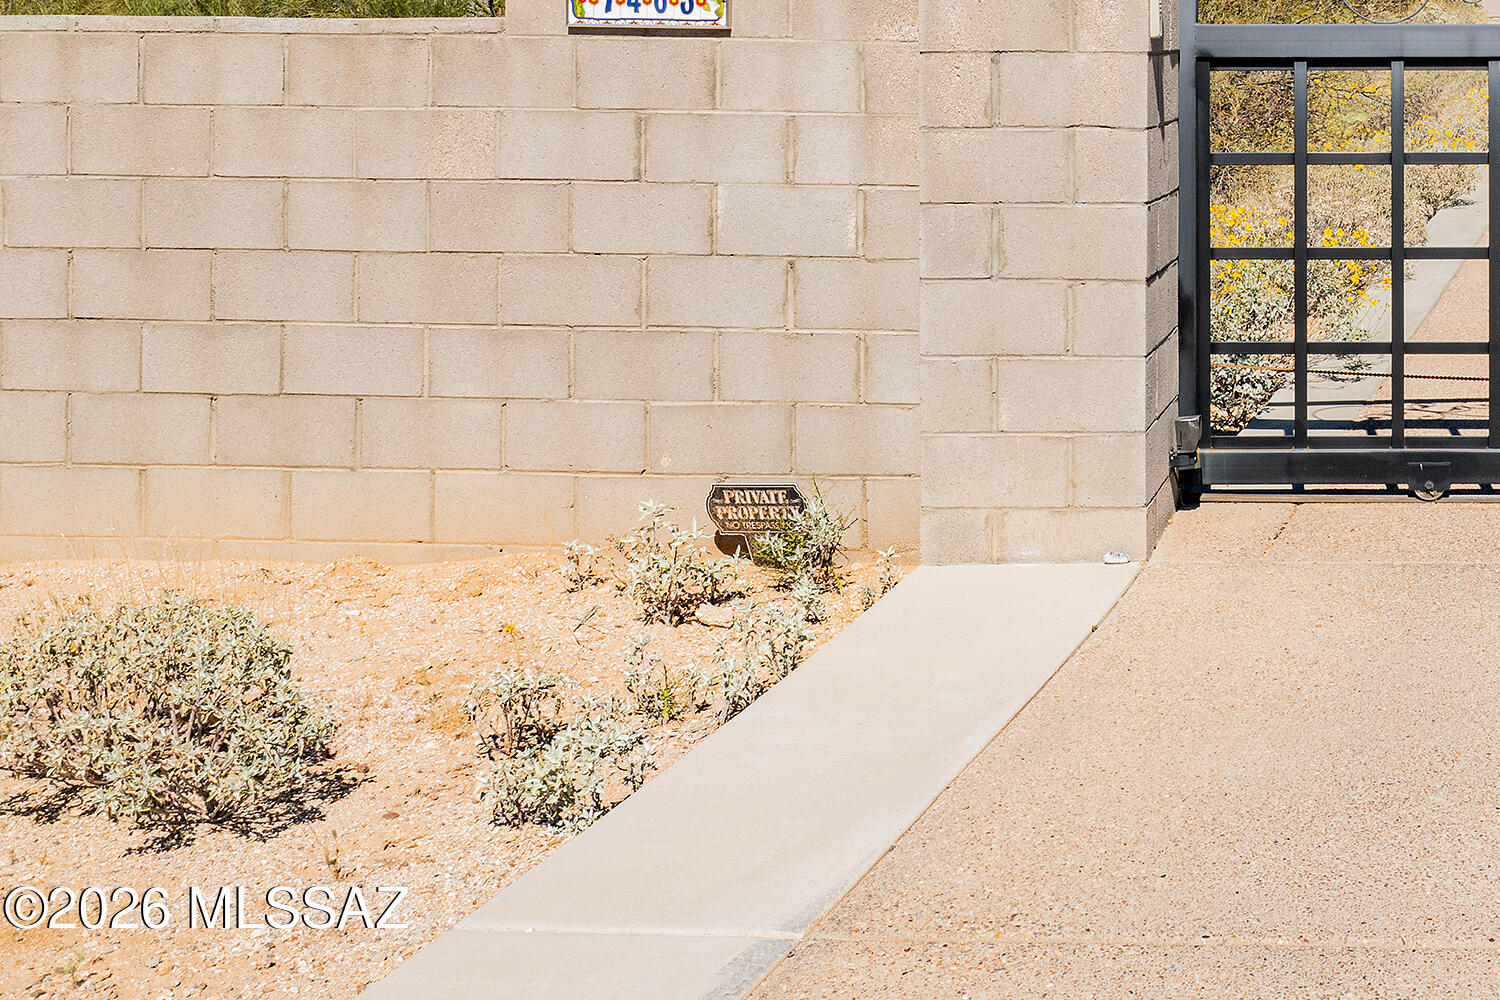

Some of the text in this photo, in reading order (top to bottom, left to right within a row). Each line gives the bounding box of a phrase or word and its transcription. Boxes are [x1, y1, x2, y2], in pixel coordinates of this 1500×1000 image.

[722, 489, 789, 504] PRIVATE
[713, 505, 801, 520] PROPERTY
[726, 521, 740, 529] NO
